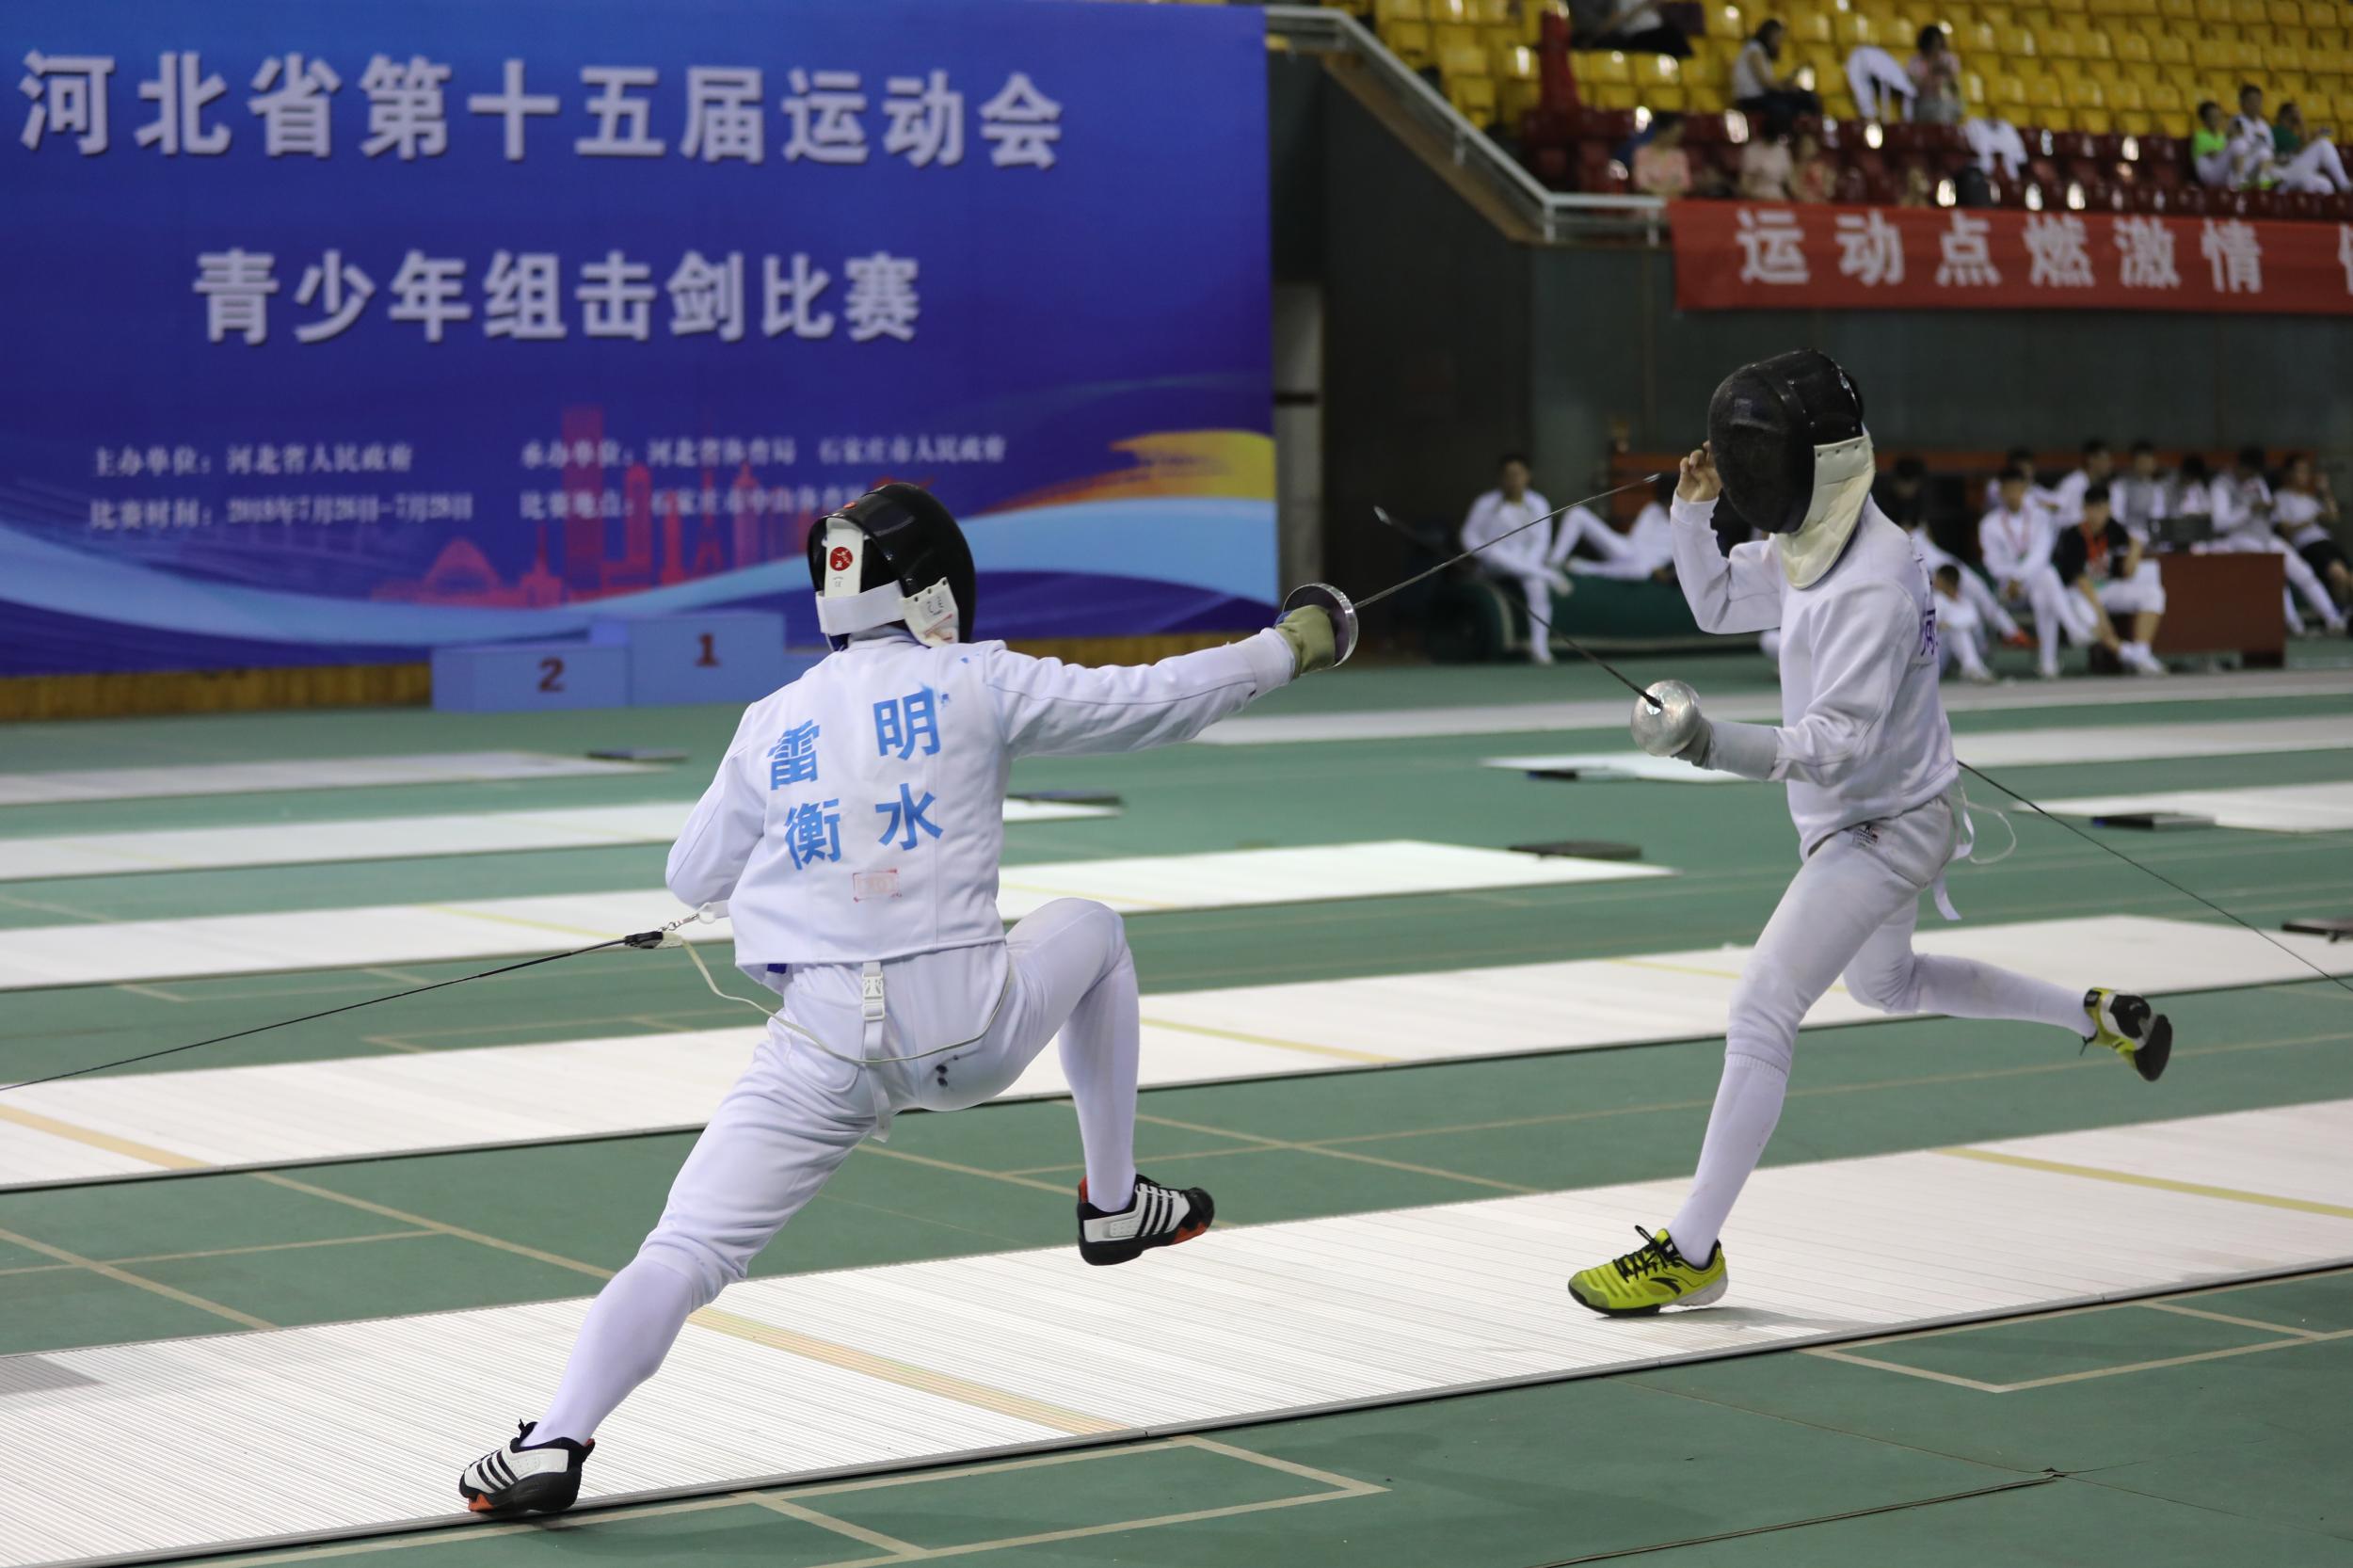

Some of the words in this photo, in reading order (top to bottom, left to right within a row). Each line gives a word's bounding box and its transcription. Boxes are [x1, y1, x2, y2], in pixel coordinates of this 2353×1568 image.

[19, 51, 1062, 168] 河北省第十五届运动会
[1737, 209, 2263, 293] 运动点燃激情
[193, 248, 920, 344] 青少年组击剑比赛
[537, 656, 565, 693] 2
[694, 632, 720, 667] 1
